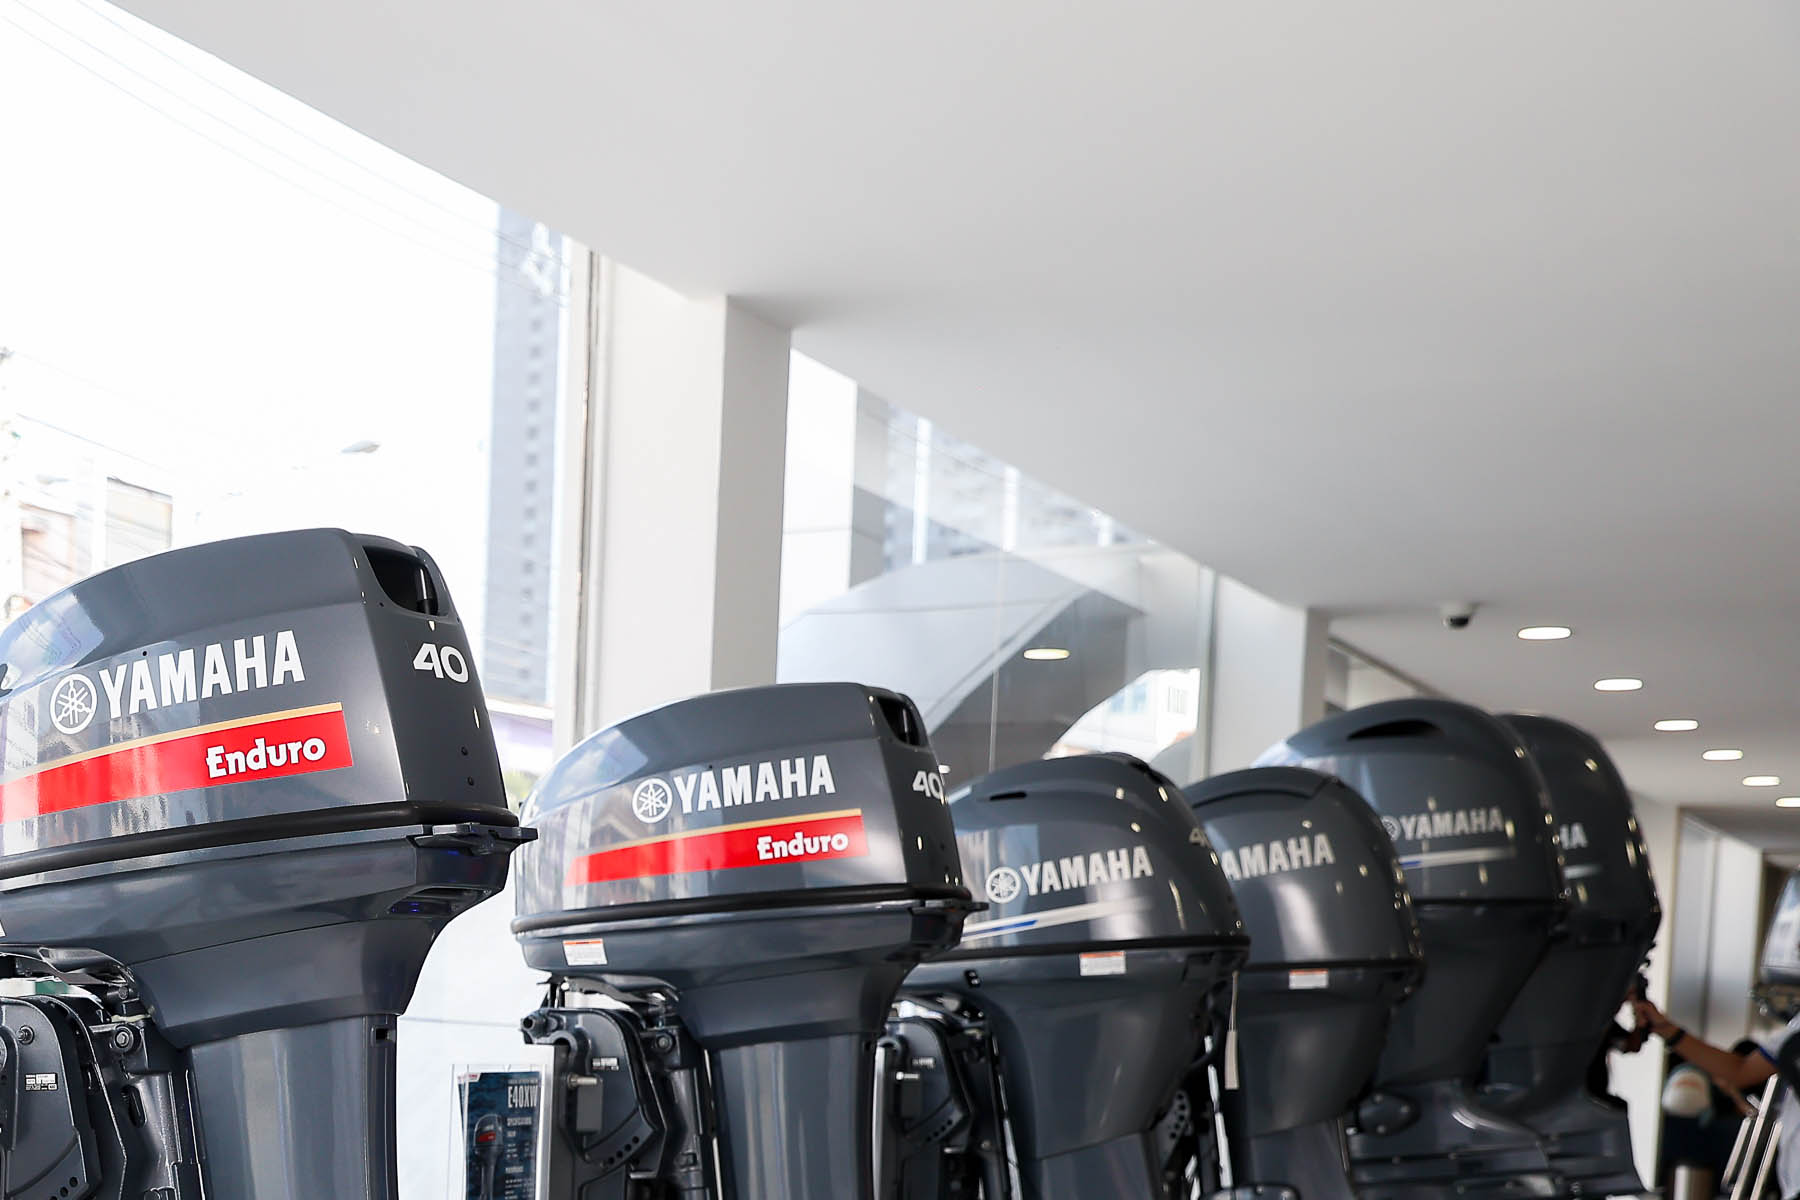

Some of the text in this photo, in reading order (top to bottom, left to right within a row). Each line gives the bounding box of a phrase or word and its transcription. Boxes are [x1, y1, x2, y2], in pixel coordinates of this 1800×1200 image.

[99, 629, 306, 719] YAMAHA
[413, 643, 469, 684] 40
[206, 736, 328, 779] Enduro
[674, 755, 837, 815] YAMAHA
[912, 769, 943, 800] 40
[1400, 806, 1505, 841] YAMAHA
[756, 832, 849, 861] Enduro
[1221, 832, 1336, 882] AMAHA
[1020, 845, 1154, 896] YAMAHA
